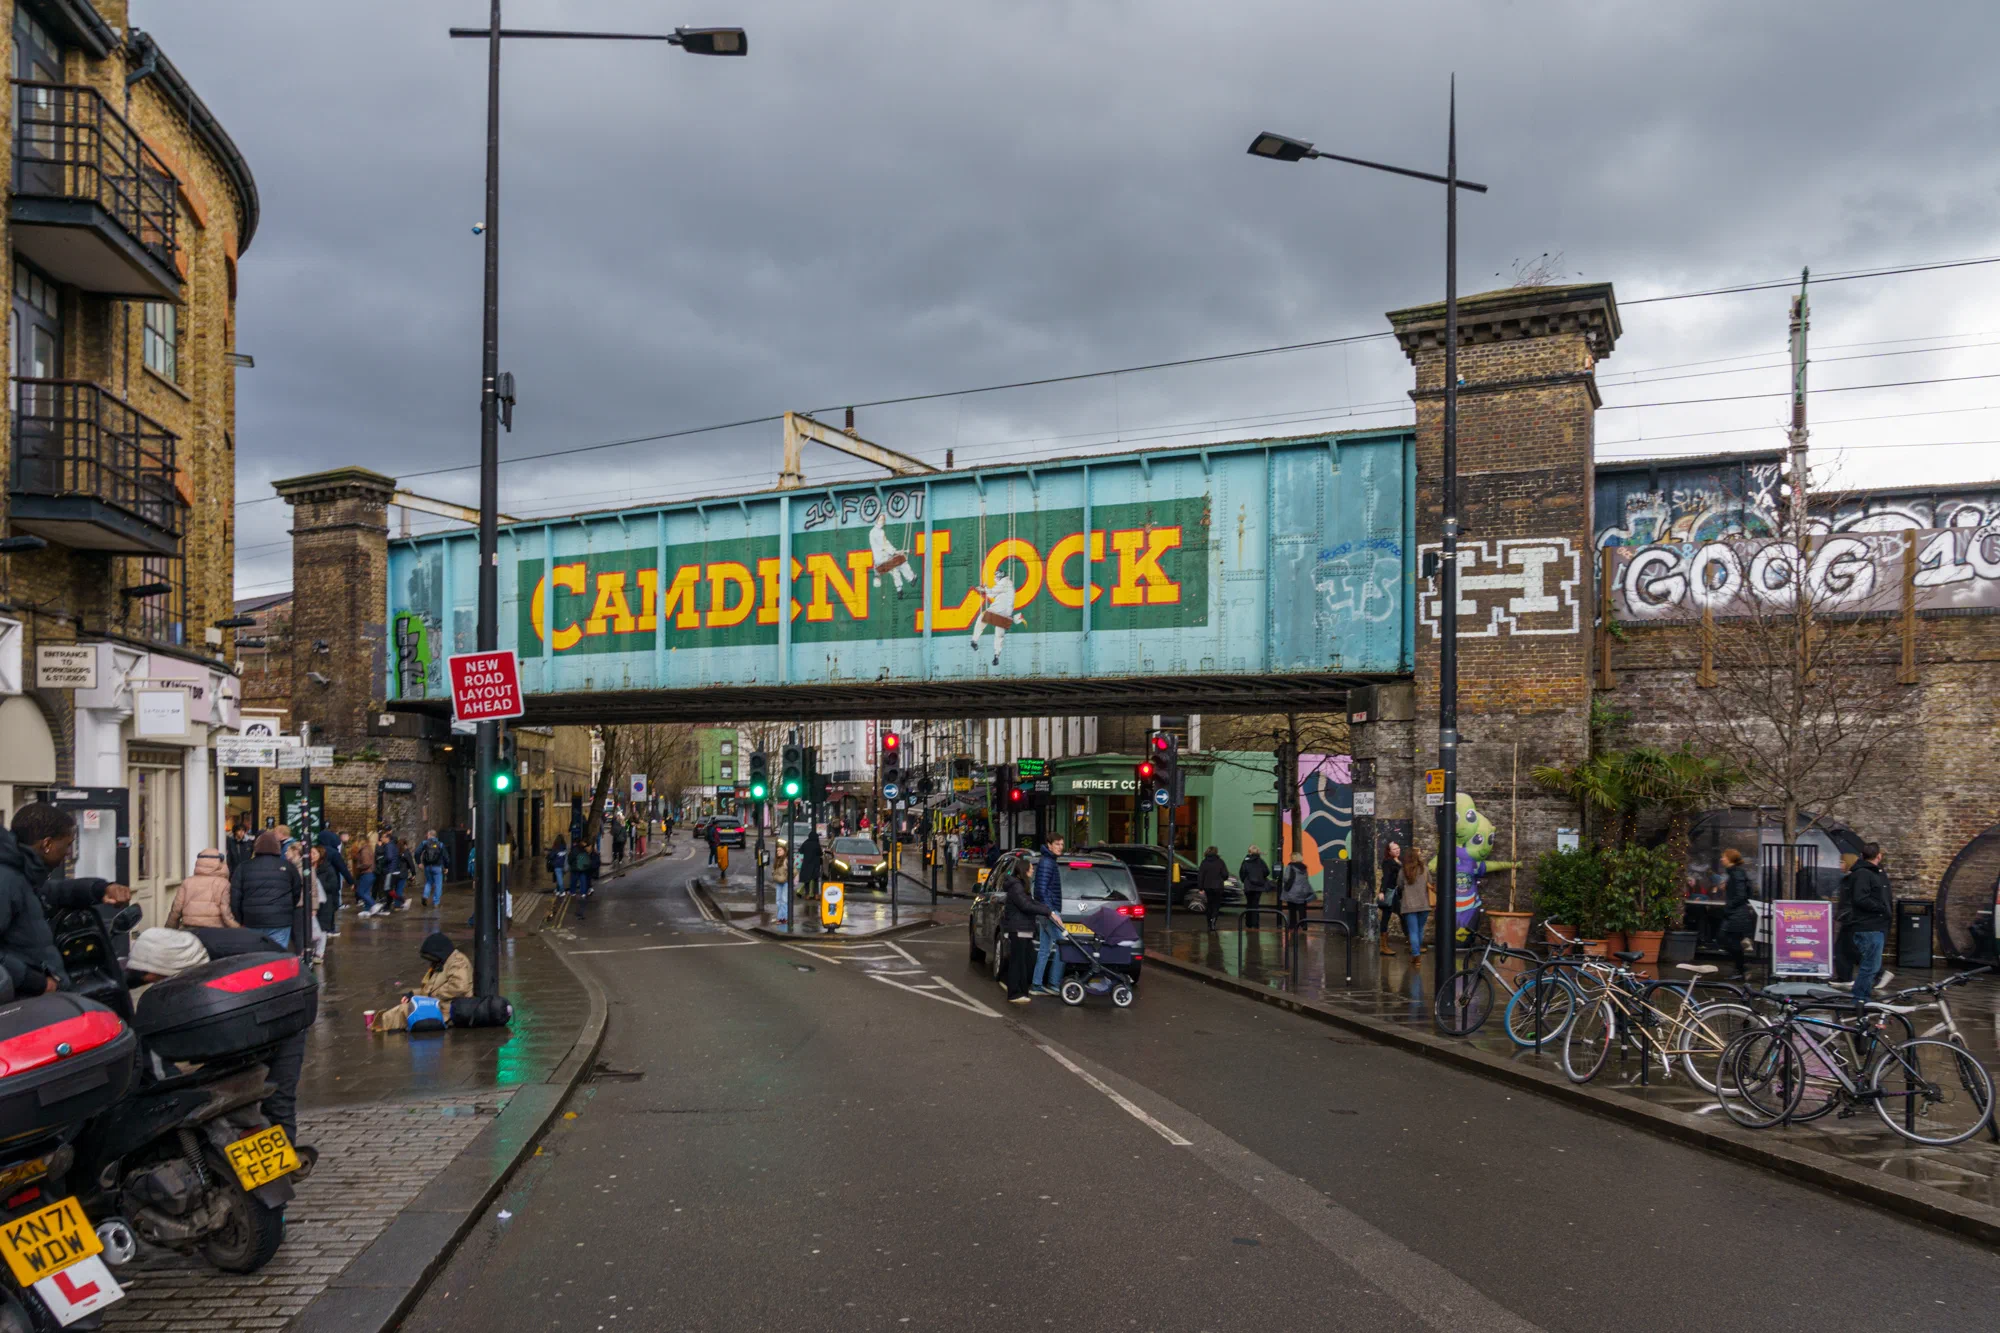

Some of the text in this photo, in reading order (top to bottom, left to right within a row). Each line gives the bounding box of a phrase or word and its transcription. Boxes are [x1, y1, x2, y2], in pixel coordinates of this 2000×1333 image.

[531, 526, 1182, 651] CAMDEN LOCK
[464, 672, 504, 687] ROAD
[465, 658, 499, 673] NEW
[459, 684, 512, 701] LAYOUT
[463, 698, 512, 714] AHEAD
[1083, 780, 1118, 789] STREET
[230, 1131, 287, 1167] FH68
[247, 1151, 292, 1183] FFZ
[5, 1204, 77, 1251] KN71
[23, 1230, 85, 1273] WDW
[52, 1270, 101, 1305] L
